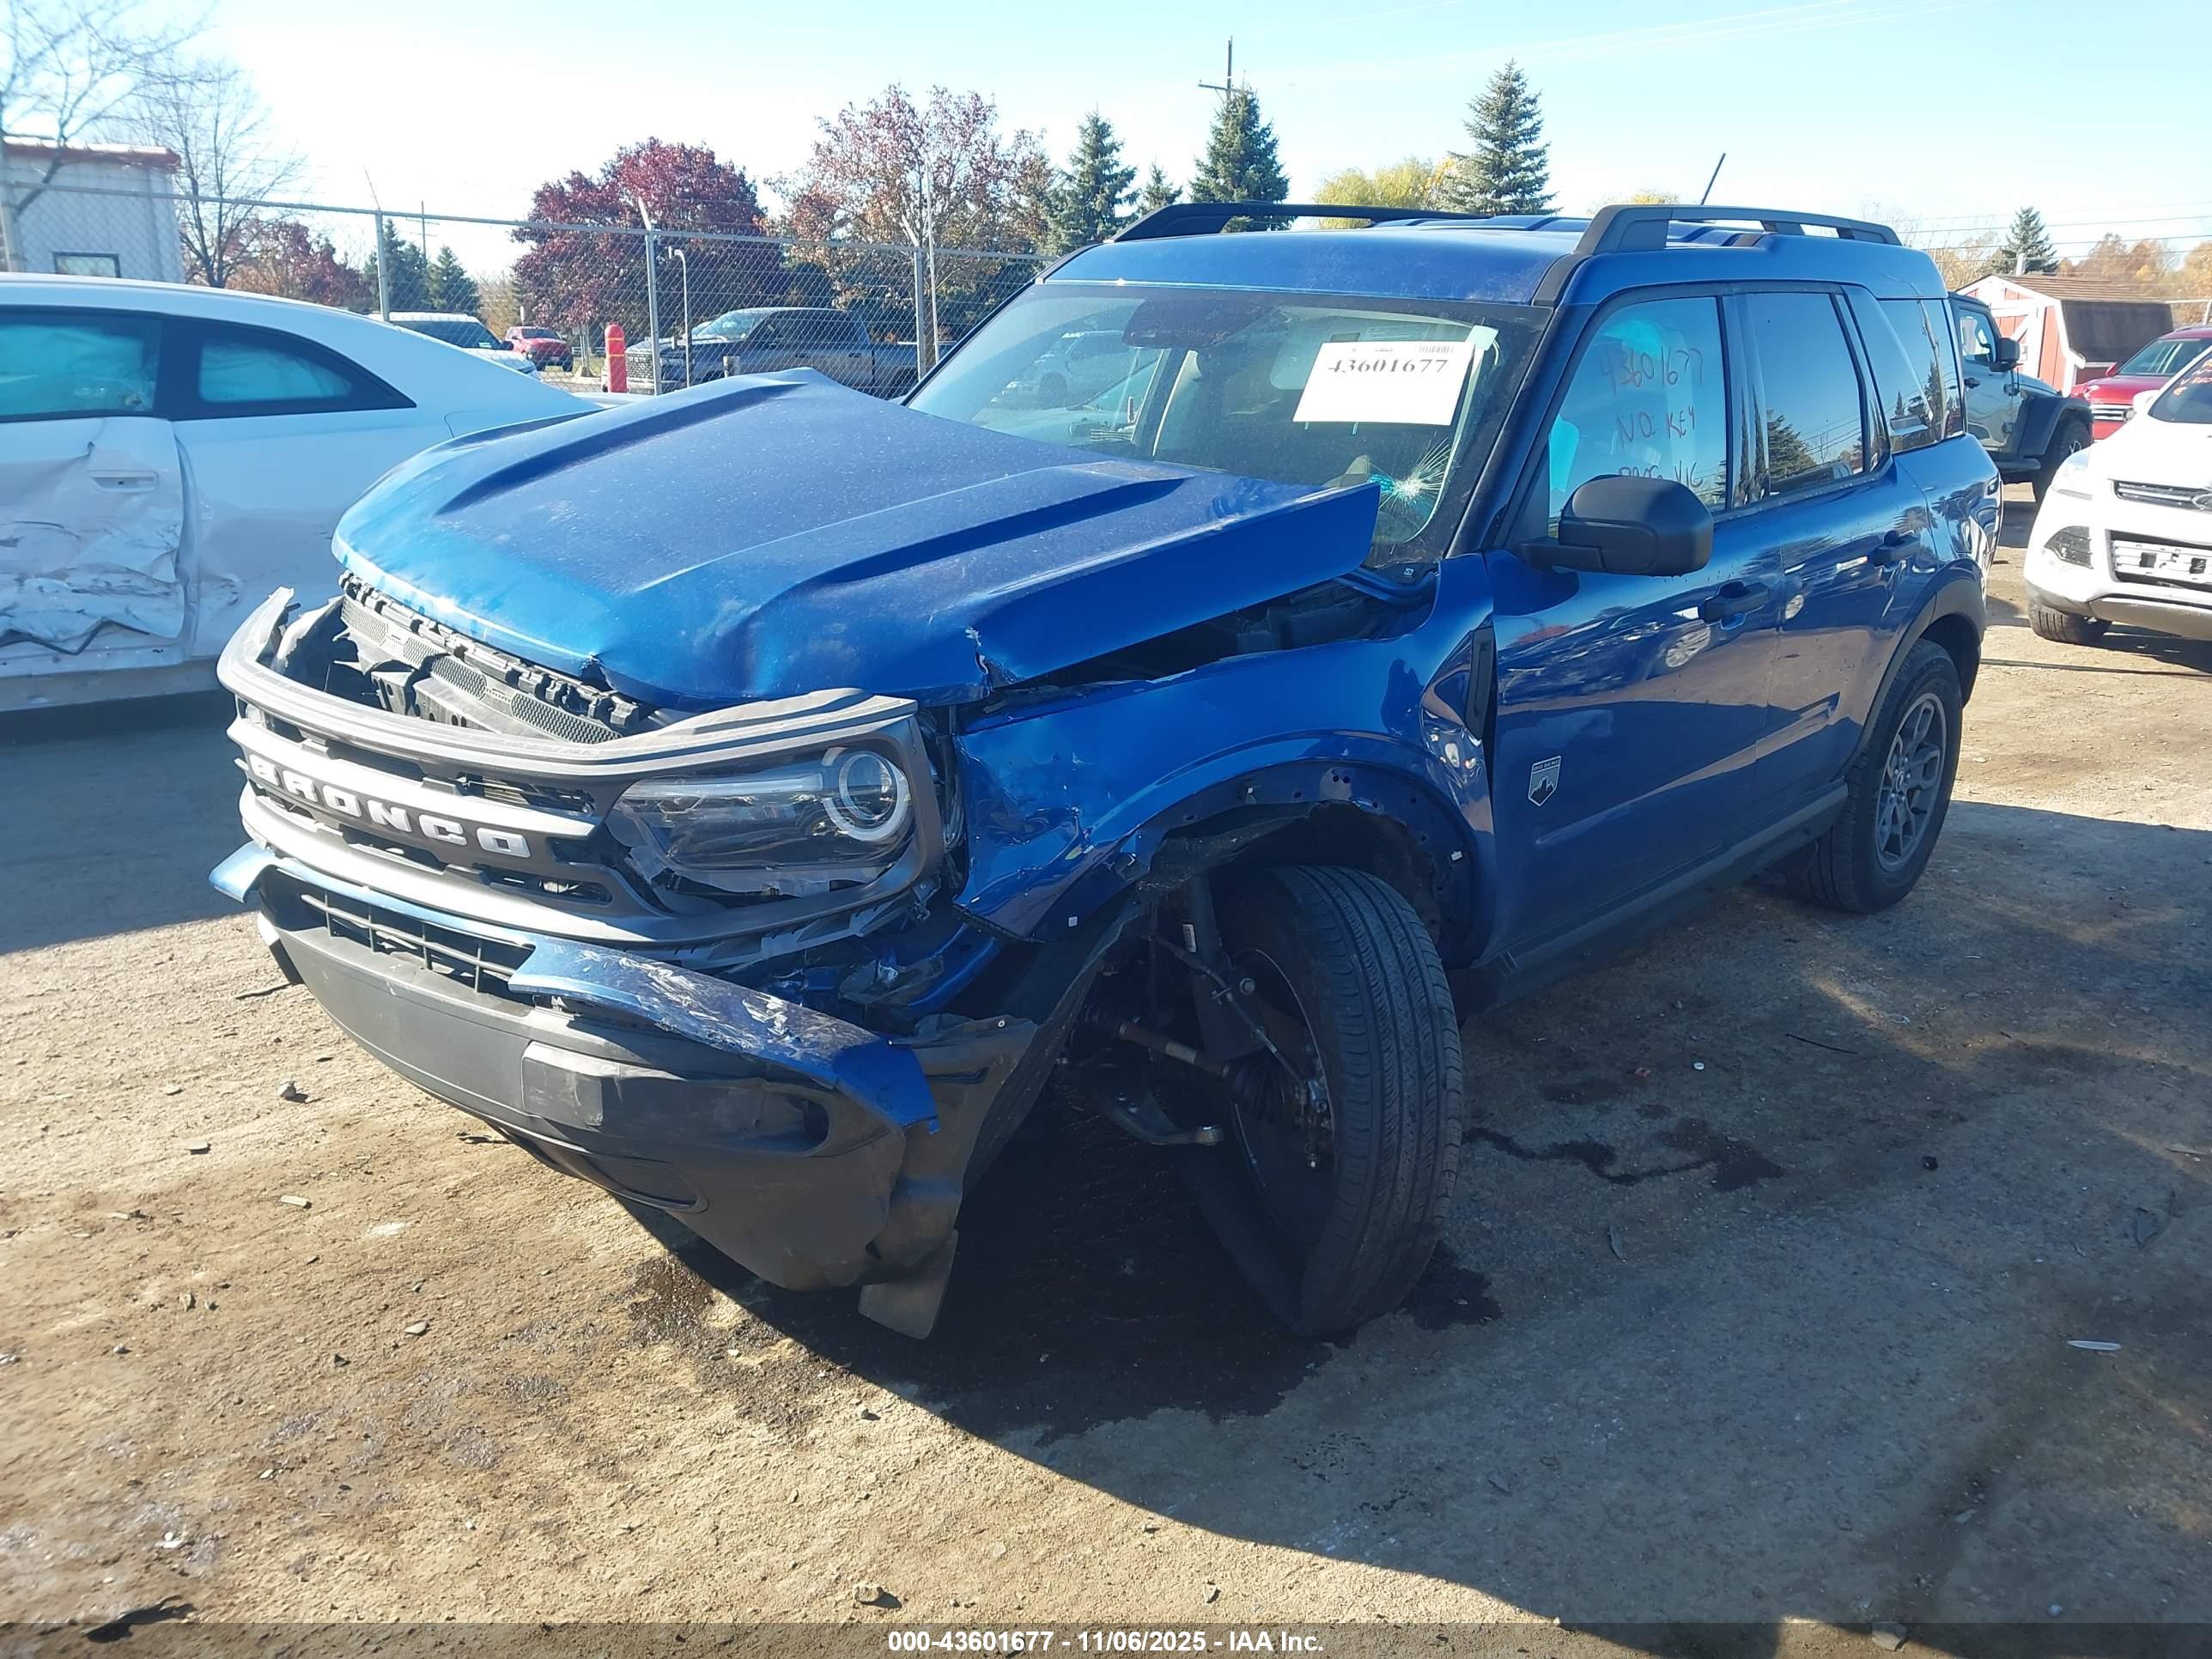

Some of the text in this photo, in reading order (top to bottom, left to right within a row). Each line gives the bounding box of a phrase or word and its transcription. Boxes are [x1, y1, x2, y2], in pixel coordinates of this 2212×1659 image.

[1328, 359, 1449, 373] 43601677
[1667, 404, 1695, 440] KEY
[249, 754, 532, 859] BRONCO
